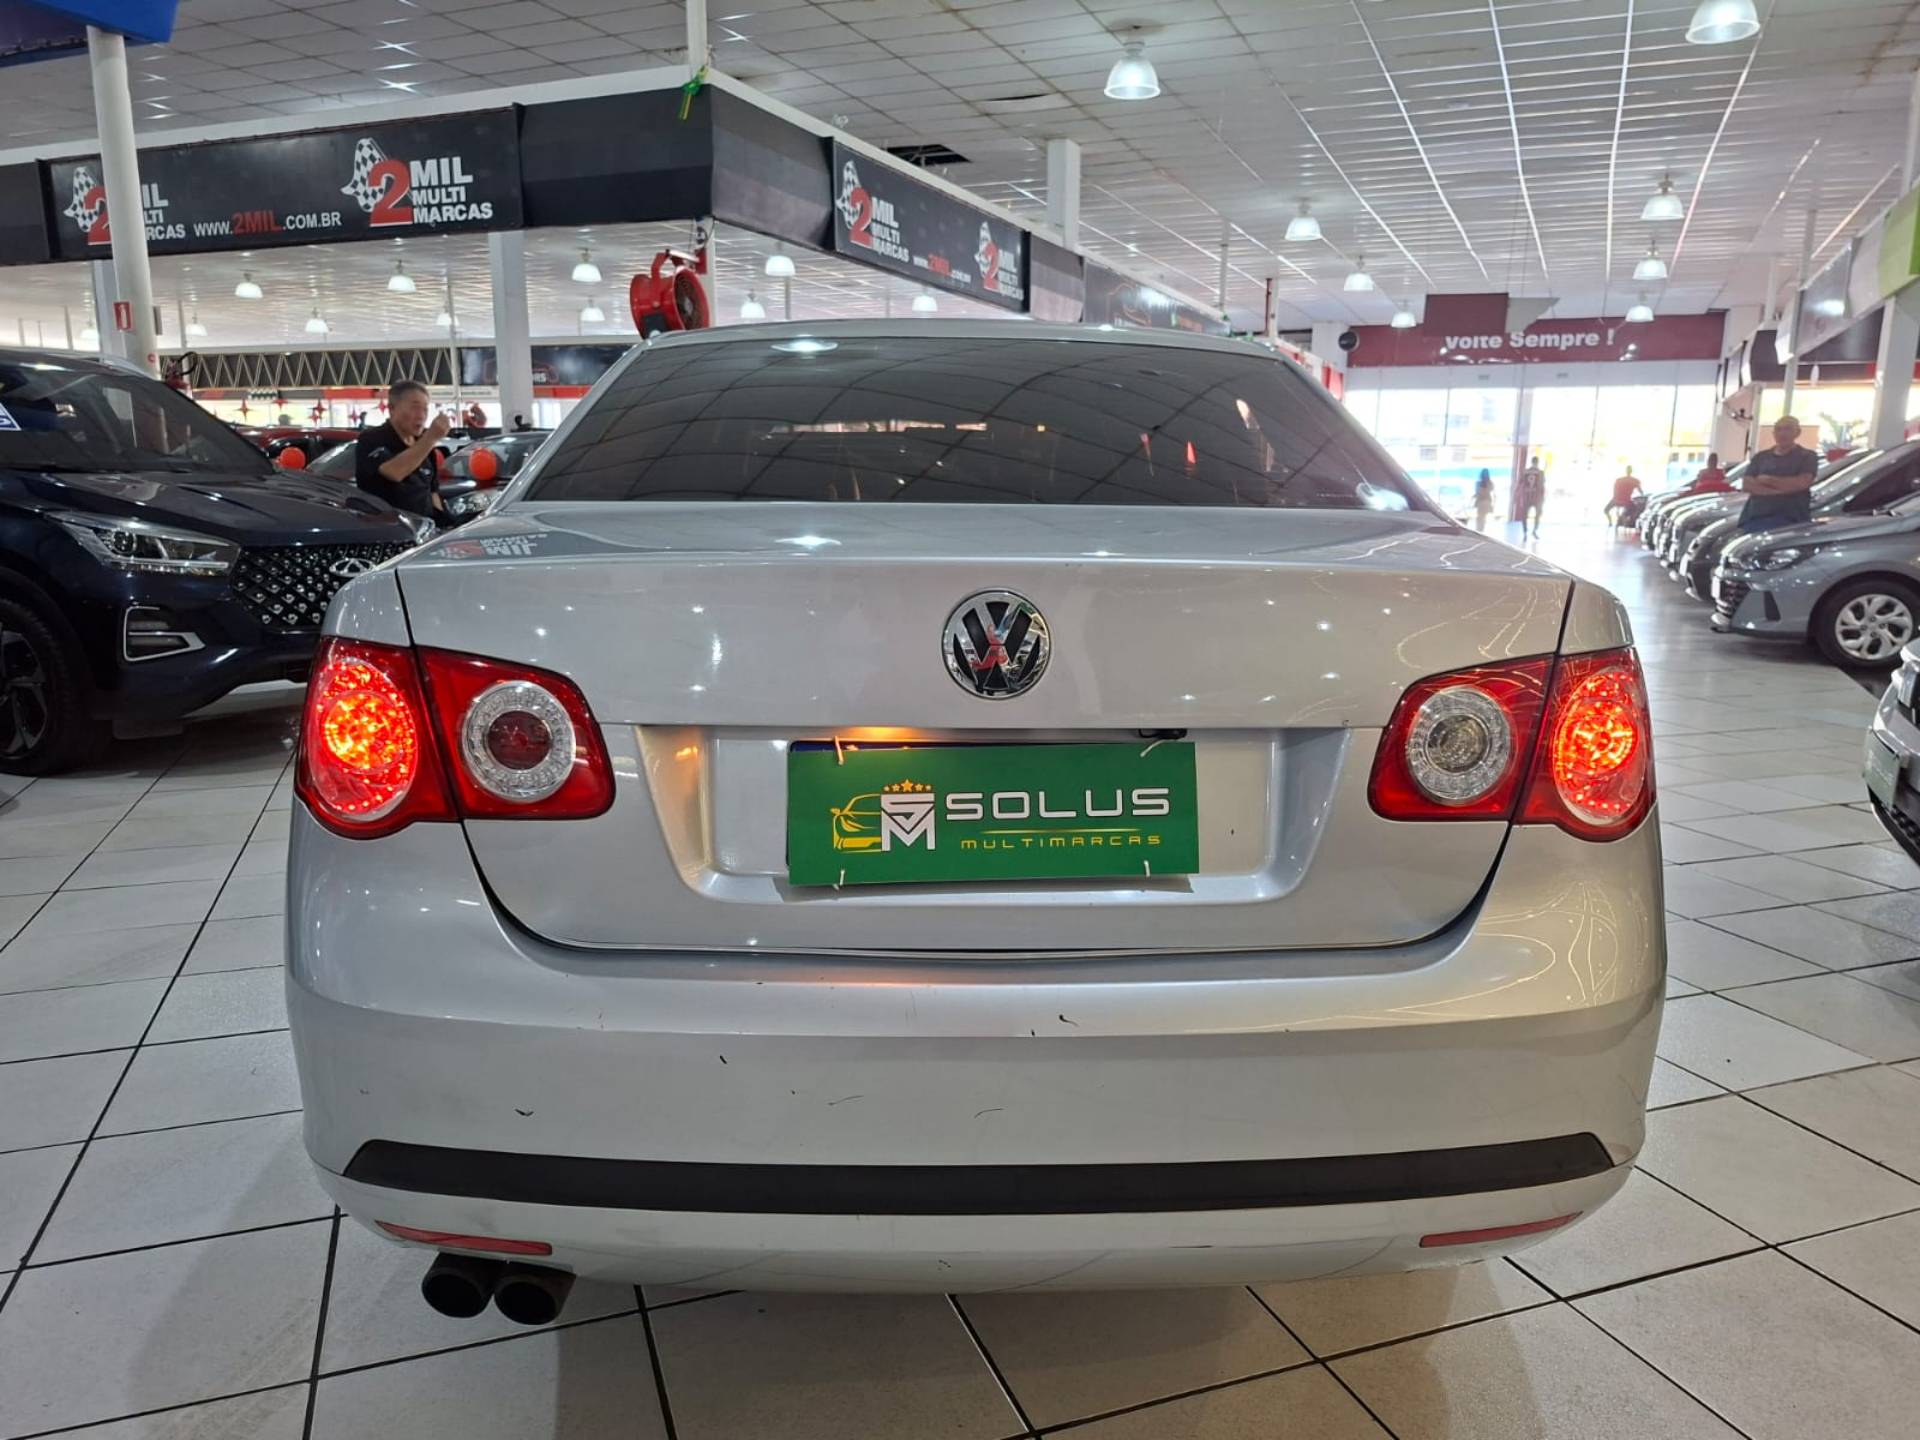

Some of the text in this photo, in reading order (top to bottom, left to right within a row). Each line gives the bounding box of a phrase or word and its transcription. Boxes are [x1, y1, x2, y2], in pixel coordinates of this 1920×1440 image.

[142, 183, 169, 208] IL
[368, 156, 473, 227] 2 MIL
[411, 186, 467, 206] MULTI
[143, 209, 164, 225] LTI
[413, 202, 494, 224] MARCAS
[849, 187, 899, 249] 2 MIL
[145, 223, 186, 241] RCAS
[870, 222, 900, 245] MULTI
[872, 236, 910, 263] MARCAS
[983, 242, 999, 290] 2
[1510, 331, 1600, 350] Sempre
[1606, 328, 1616, 346] !
[945, 788, 1170, 821] SOLUS
[960, 835, 1161, 850] MULTIMARCAS
